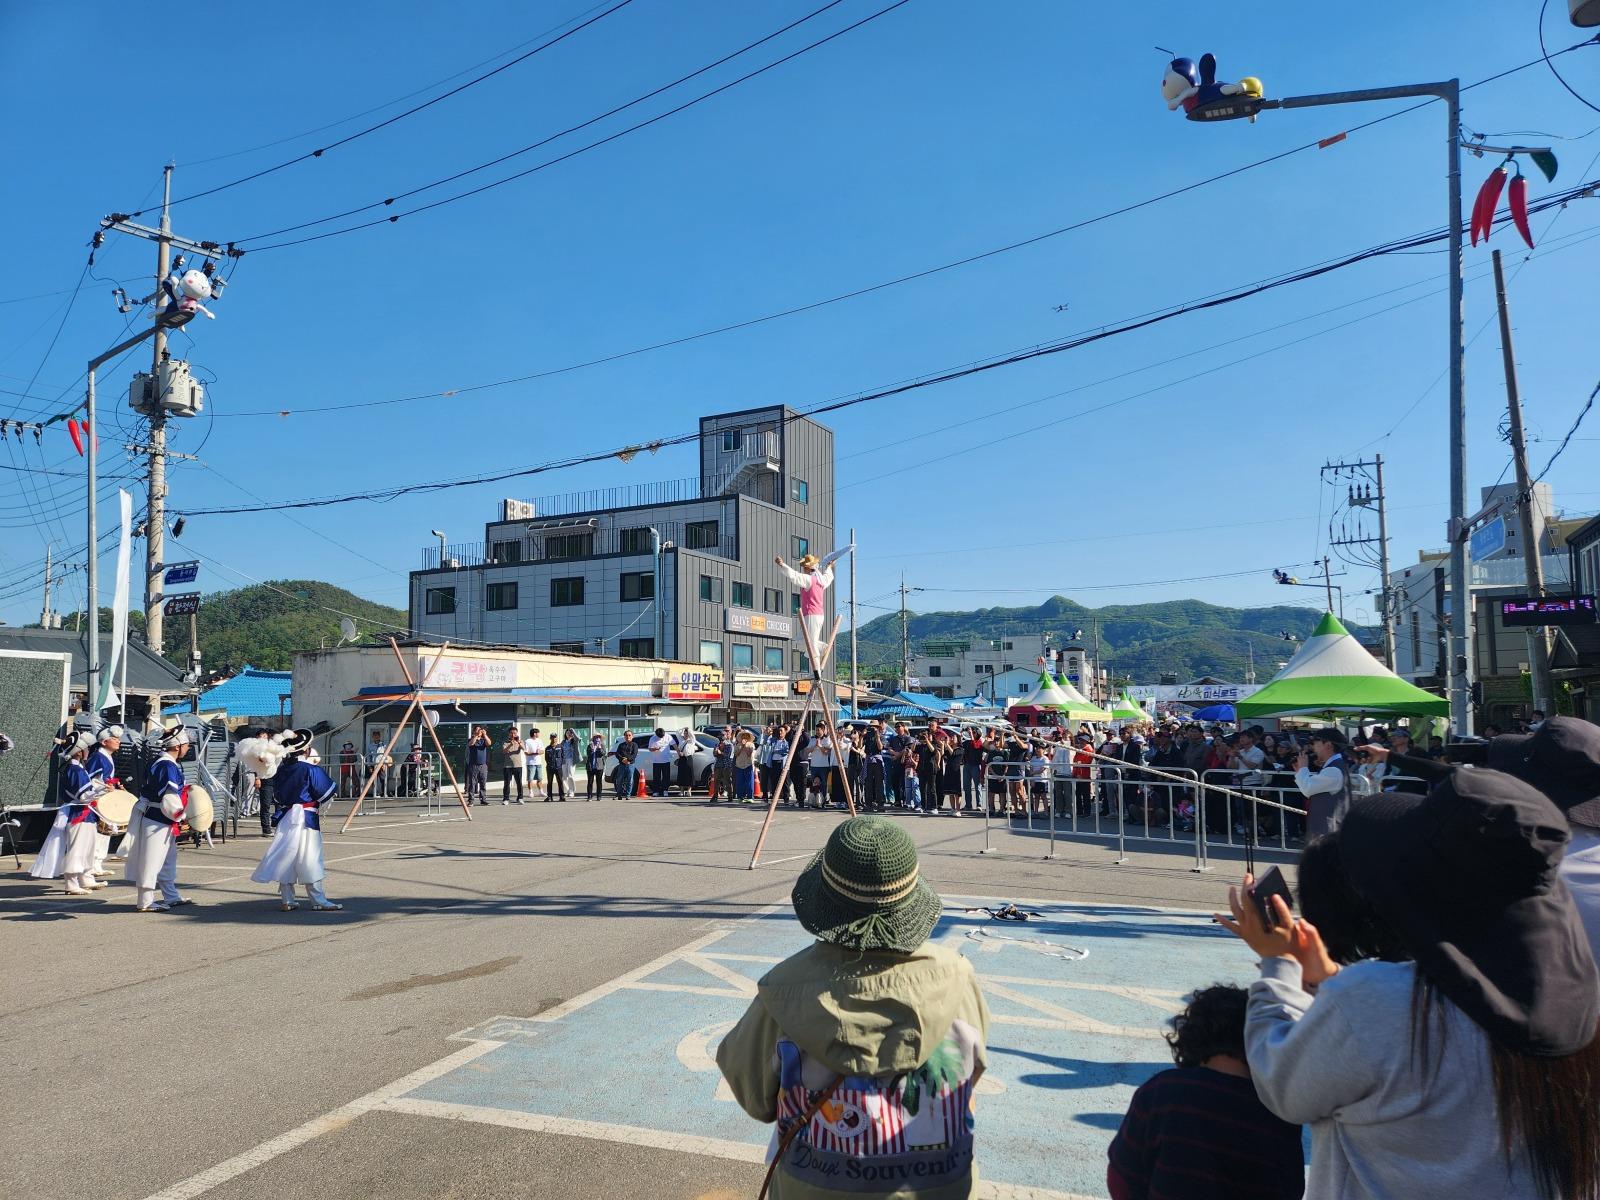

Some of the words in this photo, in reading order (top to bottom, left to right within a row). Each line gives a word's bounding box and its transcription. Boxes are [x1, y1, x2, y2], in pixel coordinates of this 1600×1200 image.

[766, 619, 790, 632] CHICKEN
[450, 661, 487, 683] 군밤
[681, 672, 721, 692] 양말천국
[791, 1145, 840, 1176] Doux
